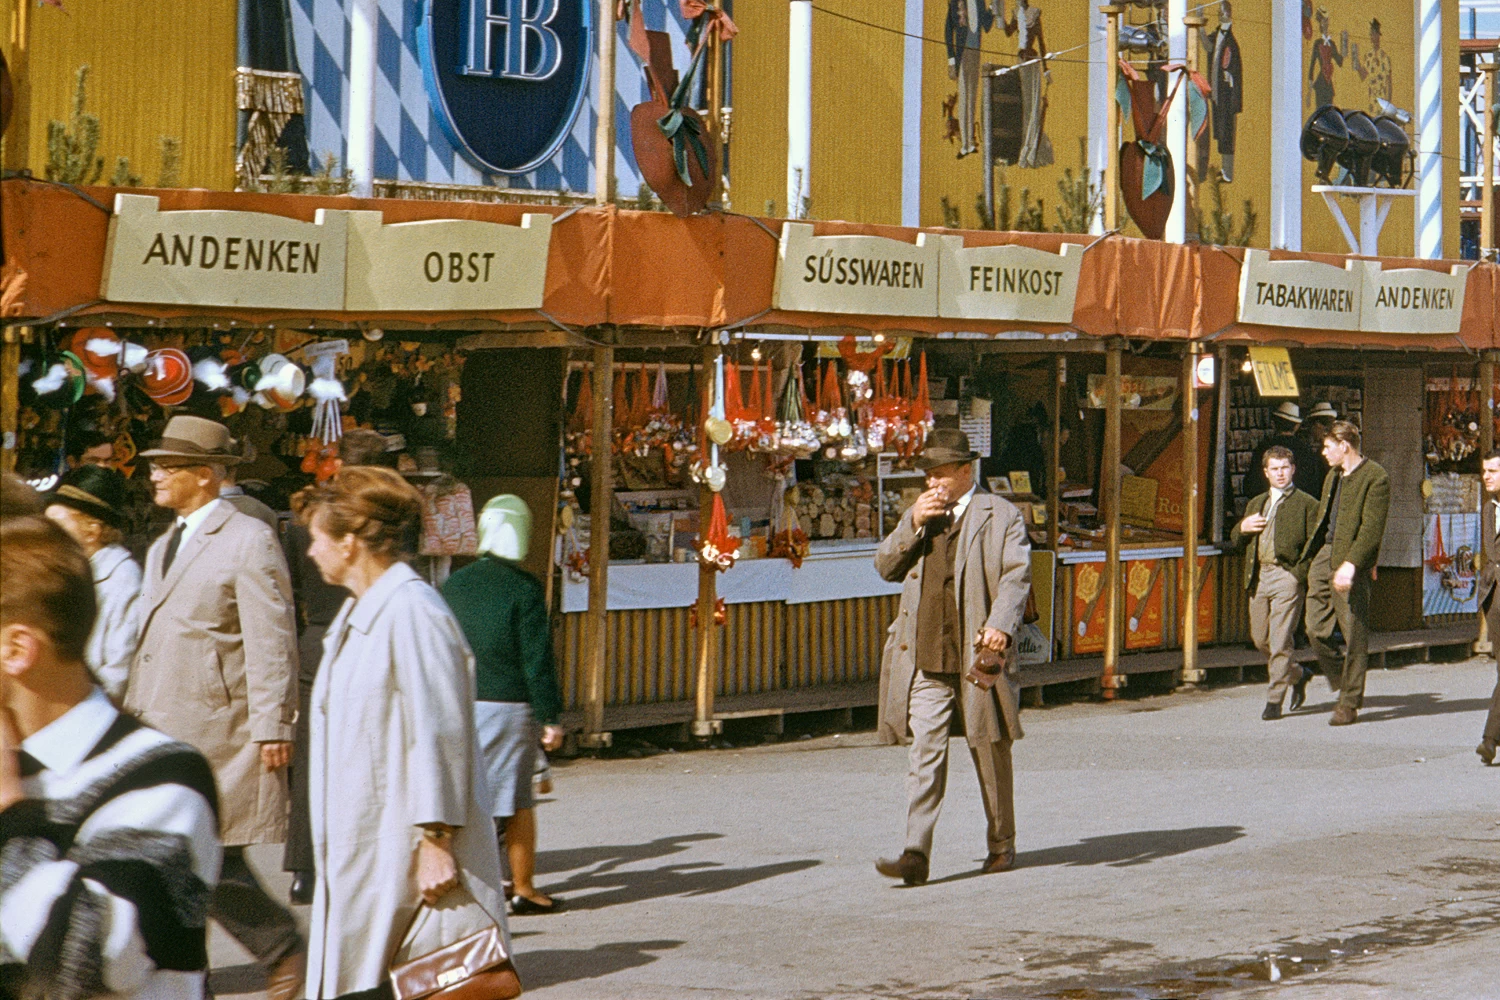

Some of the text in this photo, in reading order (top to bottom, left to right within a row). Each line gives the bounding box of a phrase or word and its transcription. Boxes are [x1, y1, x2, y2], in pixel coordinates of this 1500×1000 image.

[143, 232, 319, 274] ANDENKEN
[423, 252, 495, 283] OBST
[803, 249, 924, 289] SÜSSWAREN
[970, 265, 1062, 296] FEINKOST
[1256, 281, 1353, 313] TABAKWAREN
[1375, 285, 1454, 311] ANDENKEN
[1256, 360, 1295, 390] FILME
